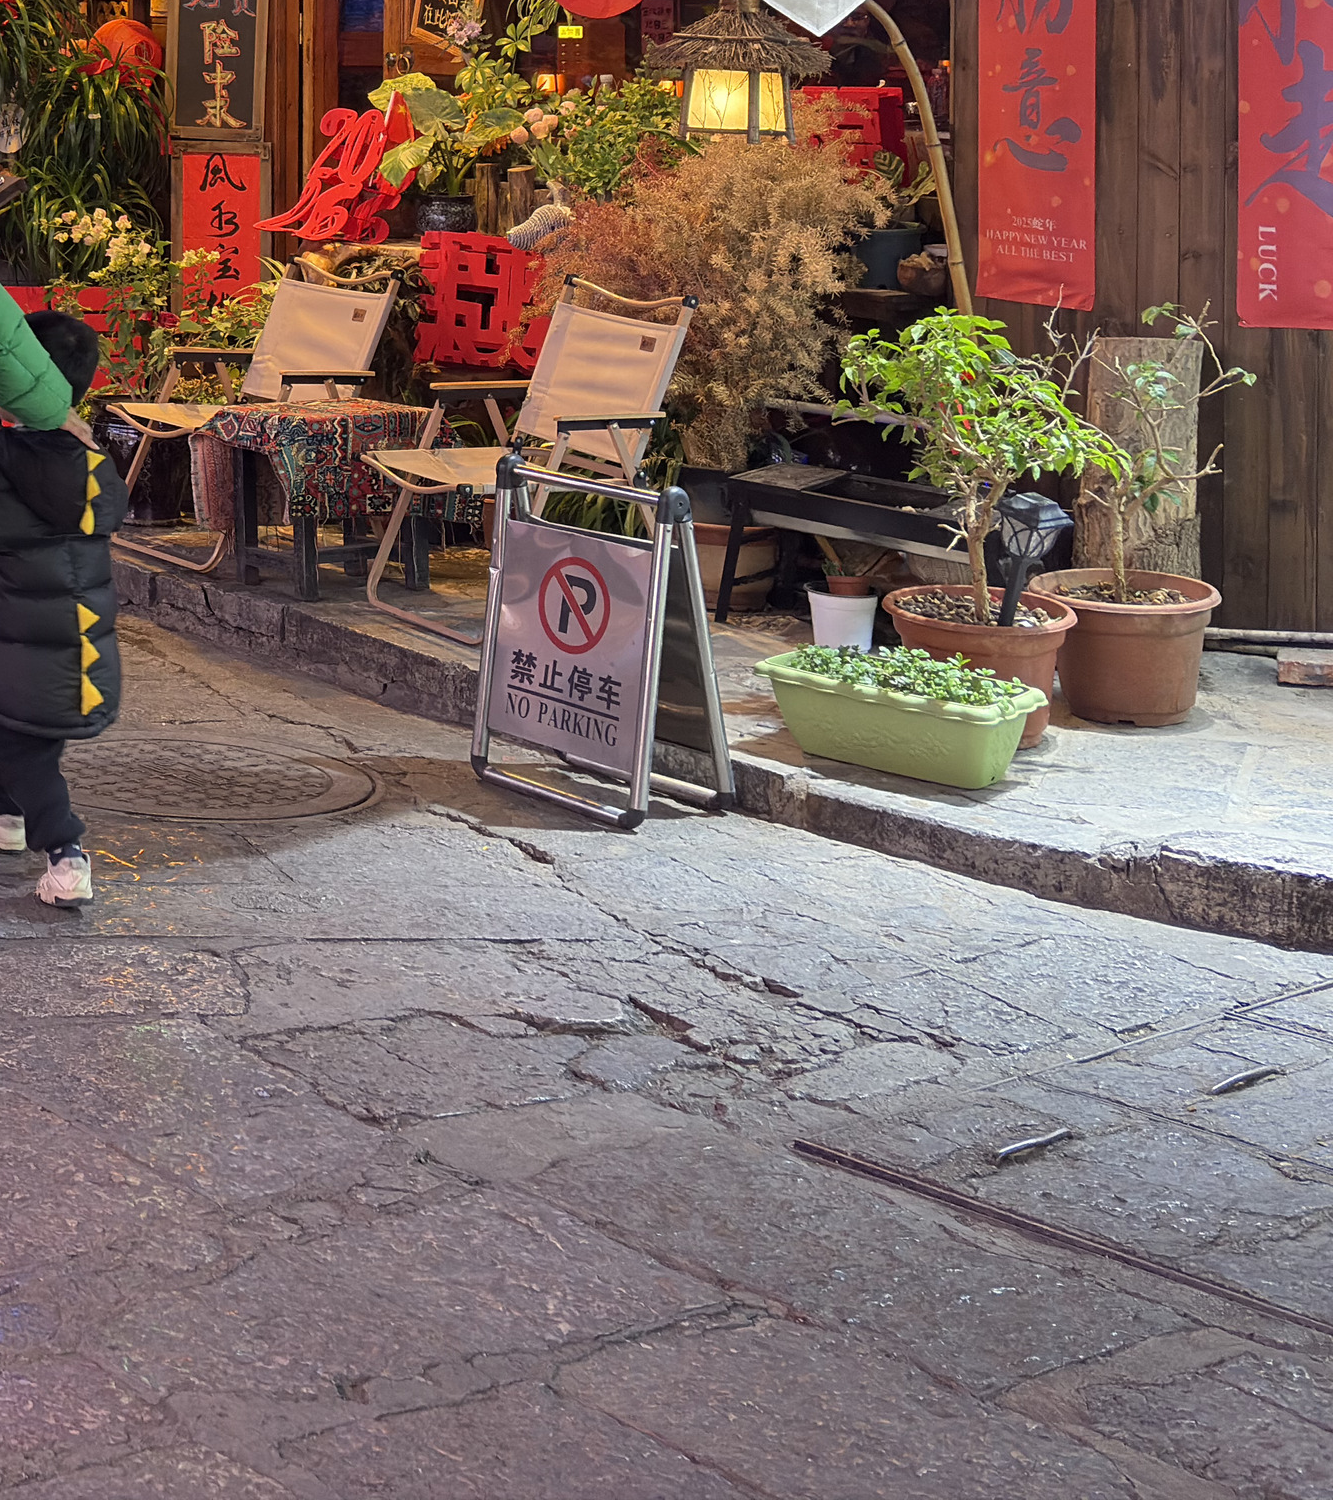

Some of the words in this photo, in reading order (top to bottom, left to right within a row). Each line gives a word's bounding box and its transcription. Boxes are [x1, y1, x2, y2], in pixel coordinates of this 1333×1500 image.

[196, 19, 247, 129] 险中求
[986, 229, 1025, 242] HAPPY
[1027, 232, 1049, 246] NEW
[1051, 236, 1087, 250] YEAR
[996, 244, 1017, 257] ALL
[1042, 249, 1074, 263] BEST
[1258, 225, 1278, 302] LUCK
[511, 649, 622, 711] 禁止停车
[505, 693, 530, 719] NO
[537, 702, 618, 747] PARKING
